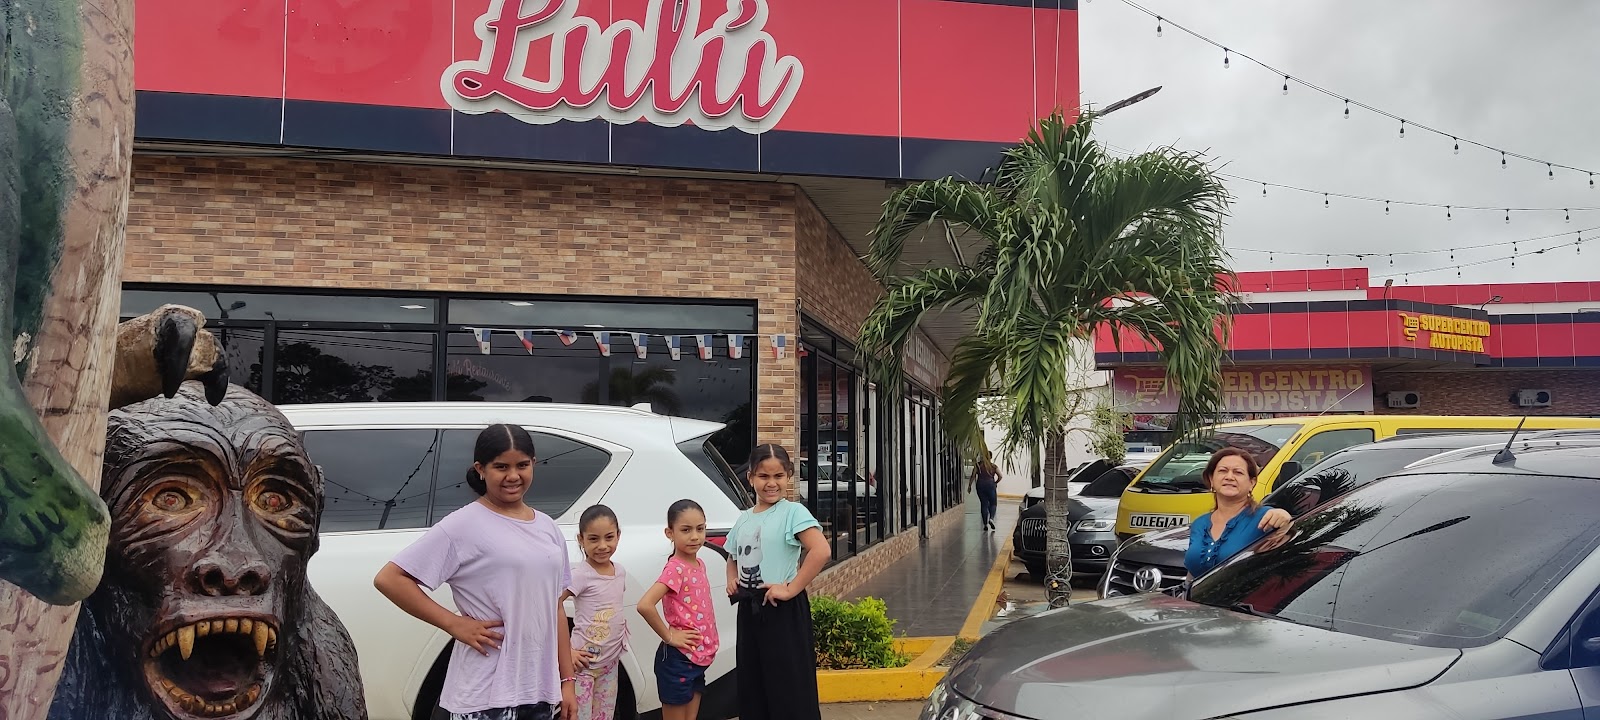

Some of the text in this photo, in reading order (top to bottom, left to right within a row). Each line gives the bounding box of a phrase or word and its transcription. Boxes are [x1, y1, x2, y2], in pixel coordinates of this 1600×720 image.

[452, 0, 796, 121] Lulú
[1420, 315, 1490, 337] SUPER CENTRO
[1430, 333, 1485, 352] AUTOPISTA
[1259, 370, 1363, 391] CENTRO
